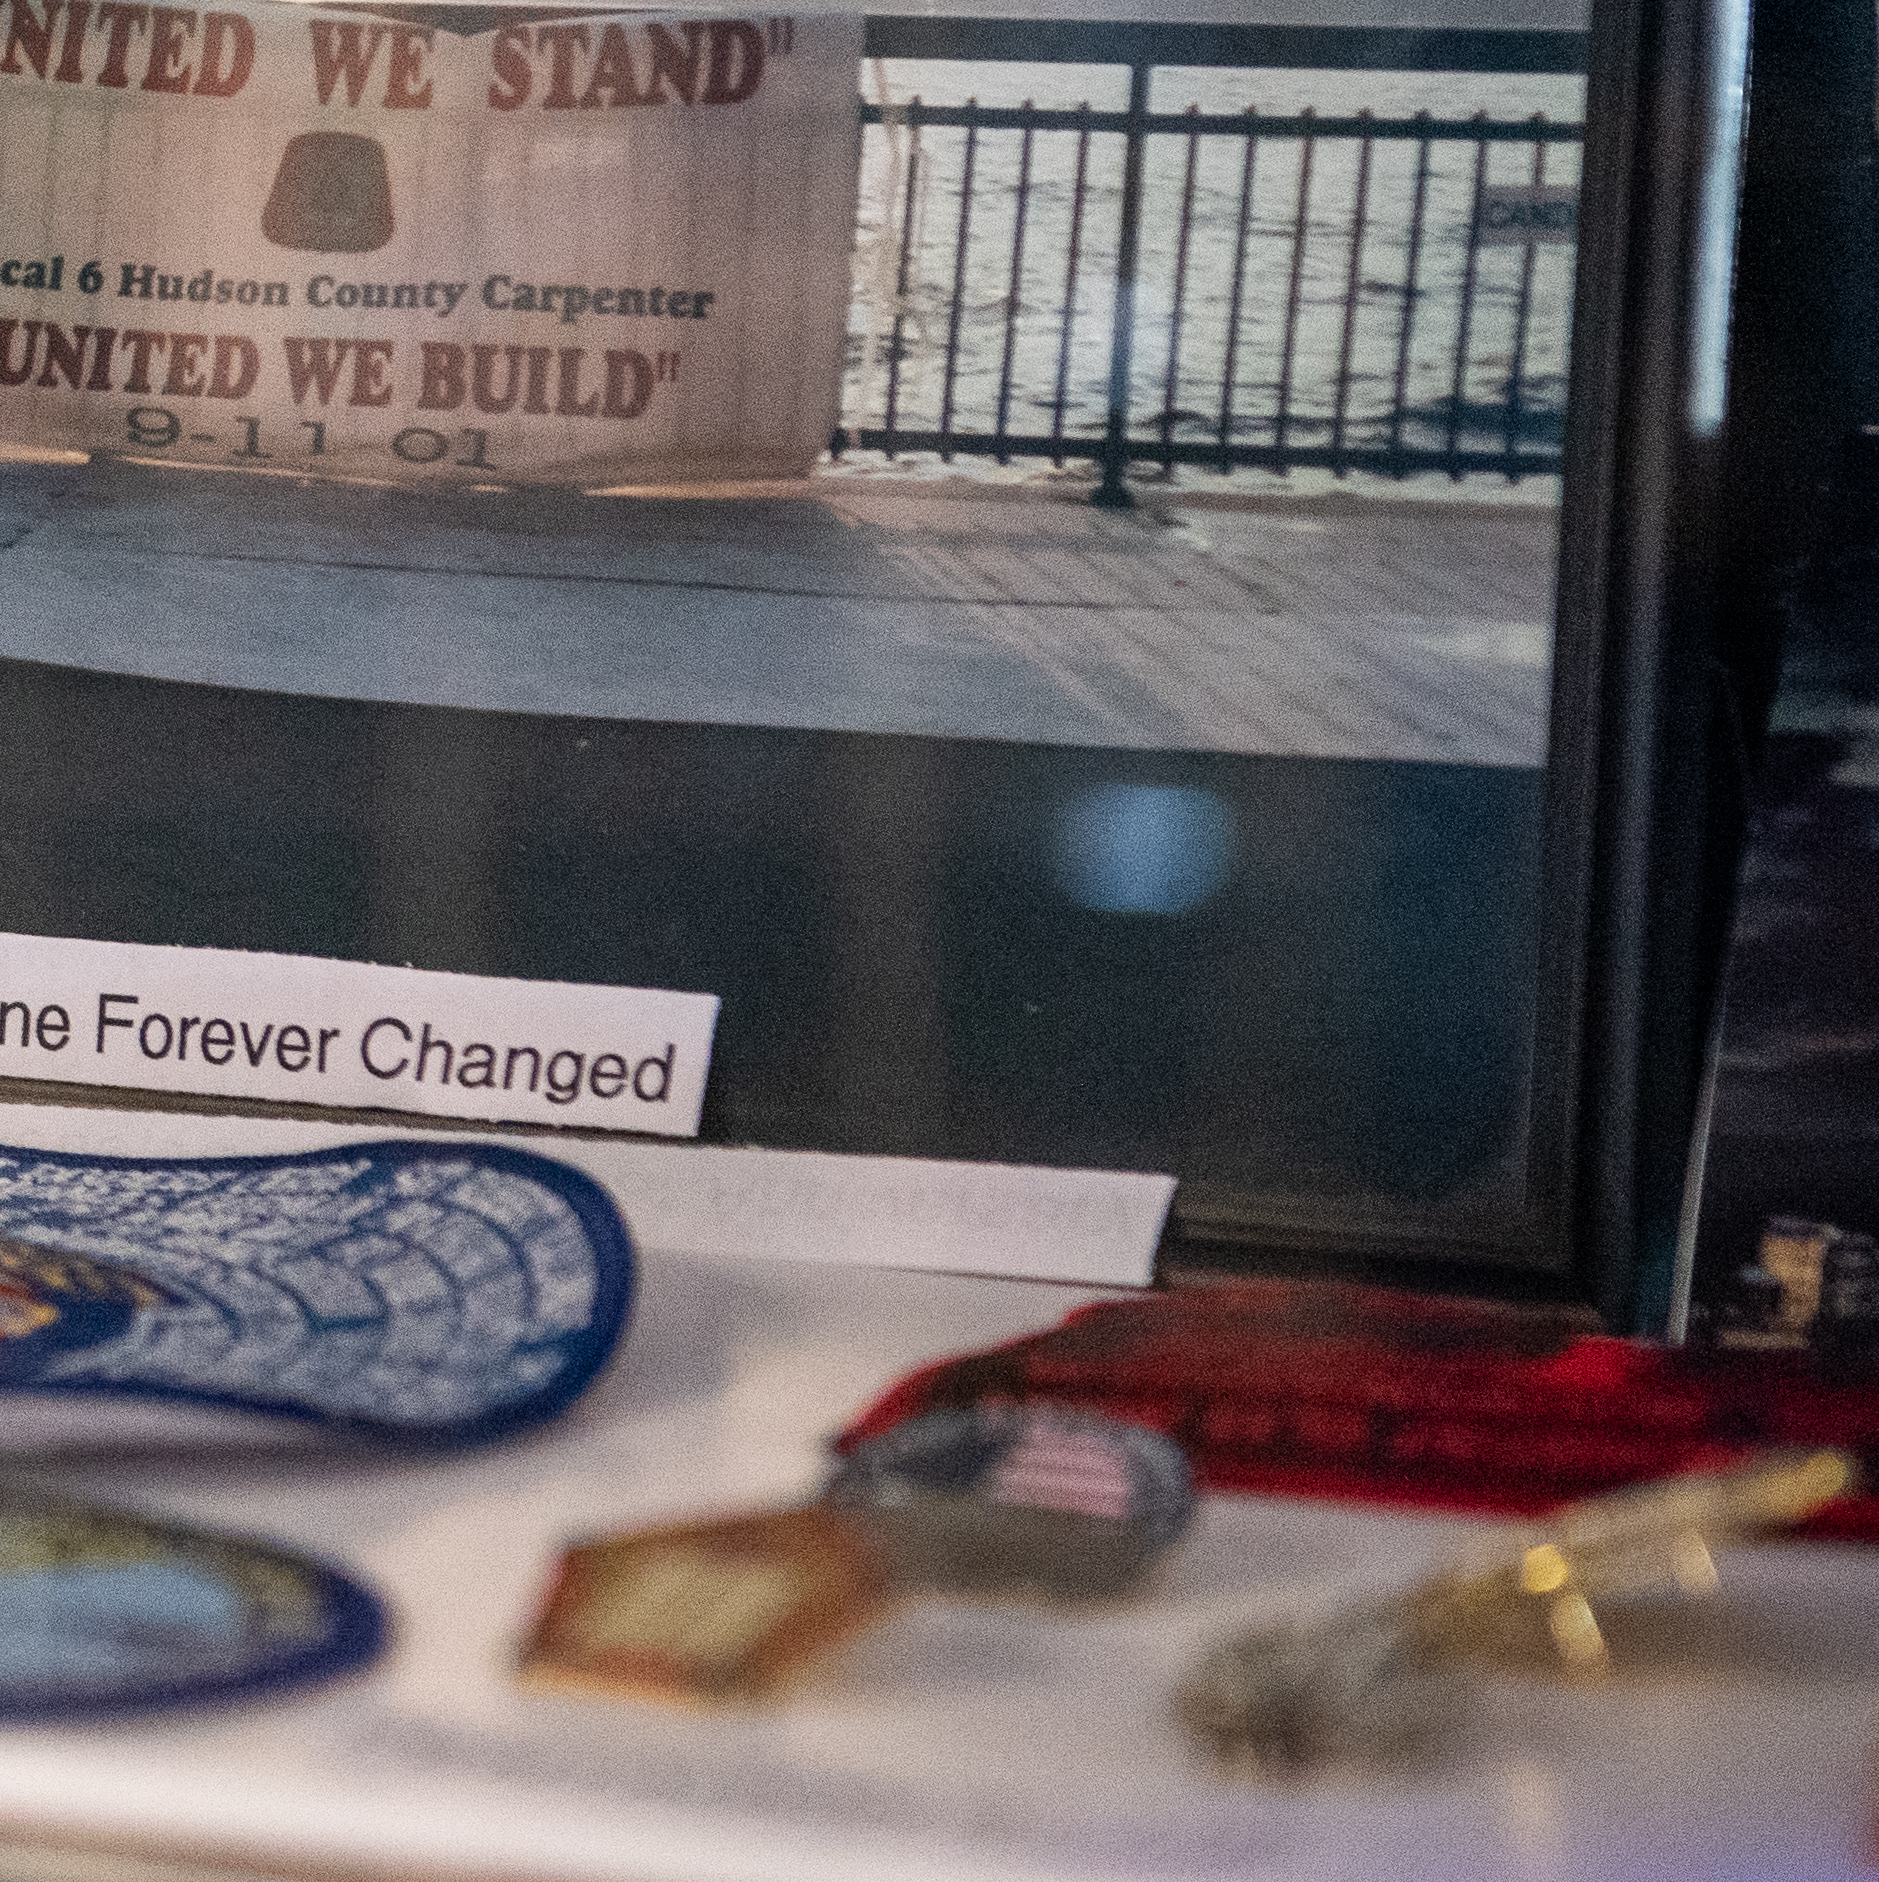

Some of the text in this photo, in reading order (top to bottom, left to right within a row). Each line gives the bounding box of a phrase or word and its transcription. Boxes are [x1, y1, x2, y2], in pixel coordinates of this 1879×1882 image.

[310, 19, 436, 109] WE
[488, 17, 794, 111] STAND"
[77, 260, 105, 295] 6
[117, 262, 290, 308] Hudson
[306, 273, 469, 320] County
[482, 273, 715, 325] Carpenter
[283, 336, 394, 407] WE
[417, 340, 681, 419] BUILD"
[96, 993, 340, 1073] Forever
[360, 1016, 676, 1105] Changed
